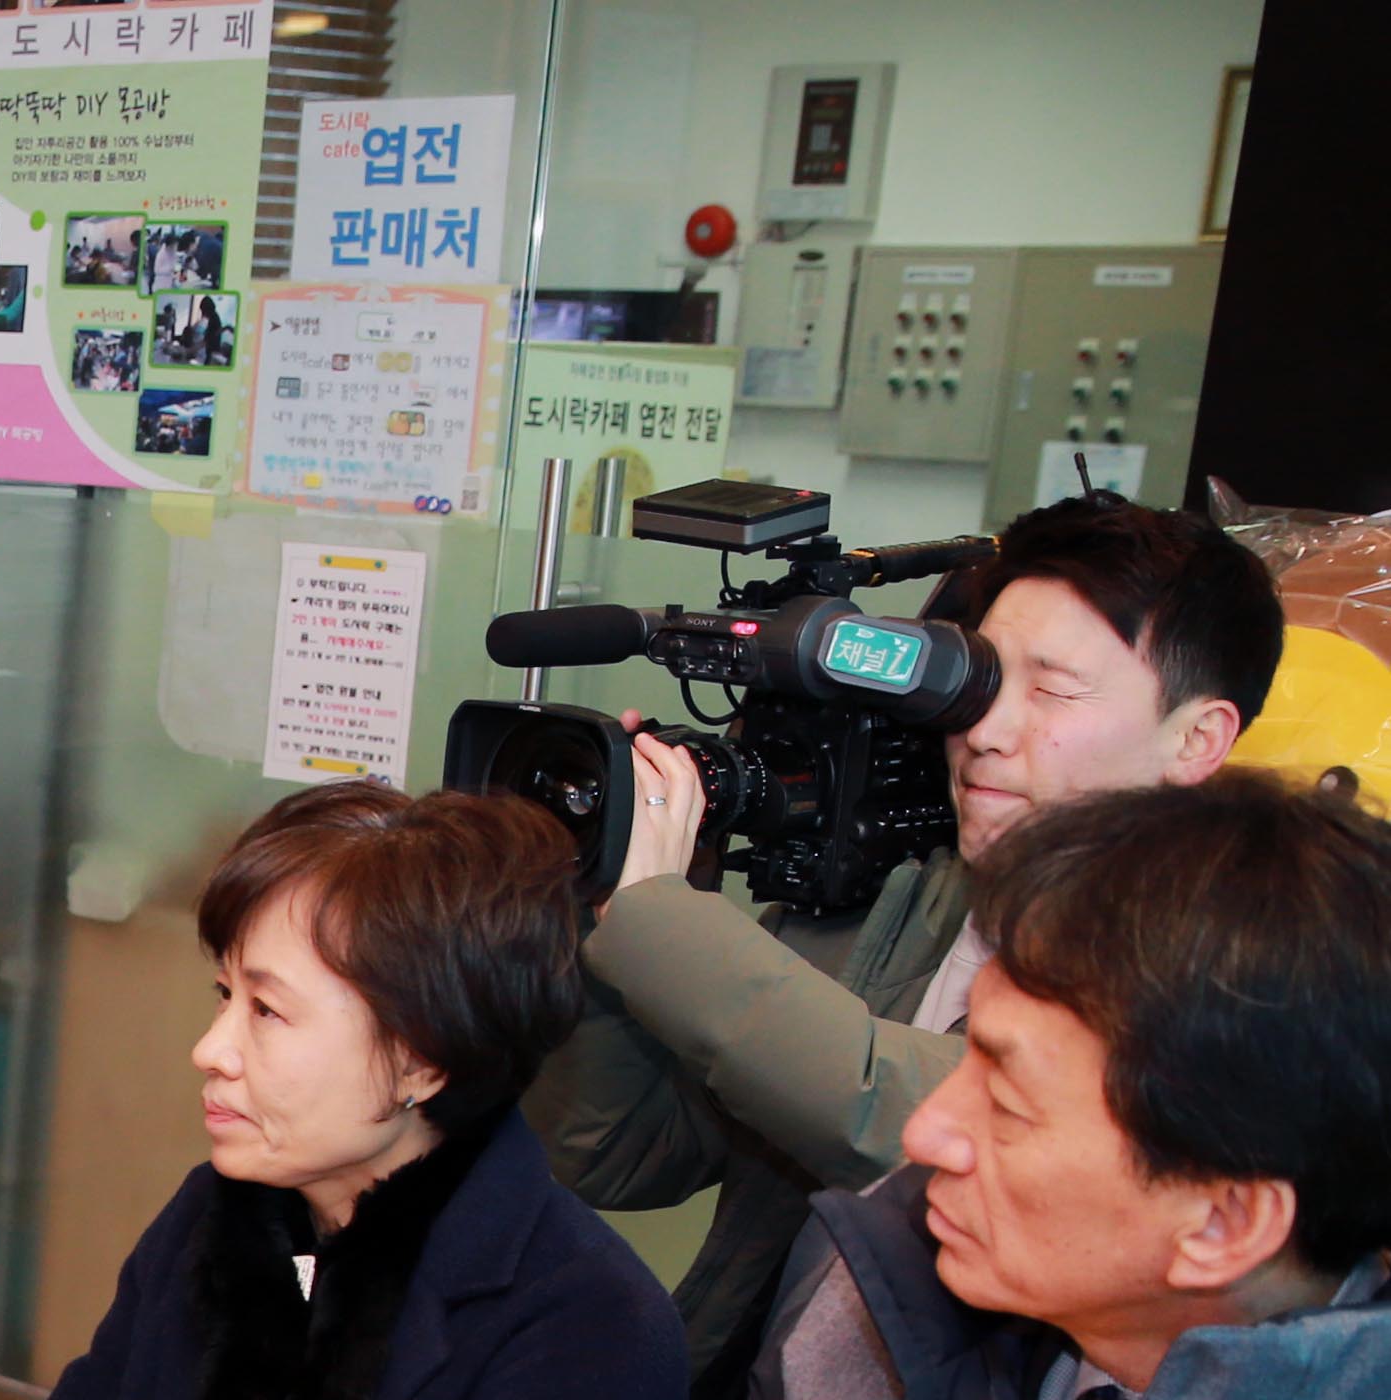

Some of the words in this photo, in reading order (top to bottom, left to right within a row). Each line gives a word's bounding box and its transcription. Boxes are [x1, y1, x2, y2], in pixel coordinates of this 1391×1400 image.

[77, 92, 108, 116] DIY
[119, 87, 170, 124] 목공방
[319, 112, 370, 132] 도시락
[113, 136, 138, 147] 100%
[322, 140, 361, 158] cafe
[361, 123, 462, 186] 엽전
[329, 206, 481, 269] 판매처
[523, 396, 630, 436] 도시락카페
[640, 402, 677, 439] 엽전
[686, 405, 722, 442] 전달
[686, 618, 716, 627] SONY
